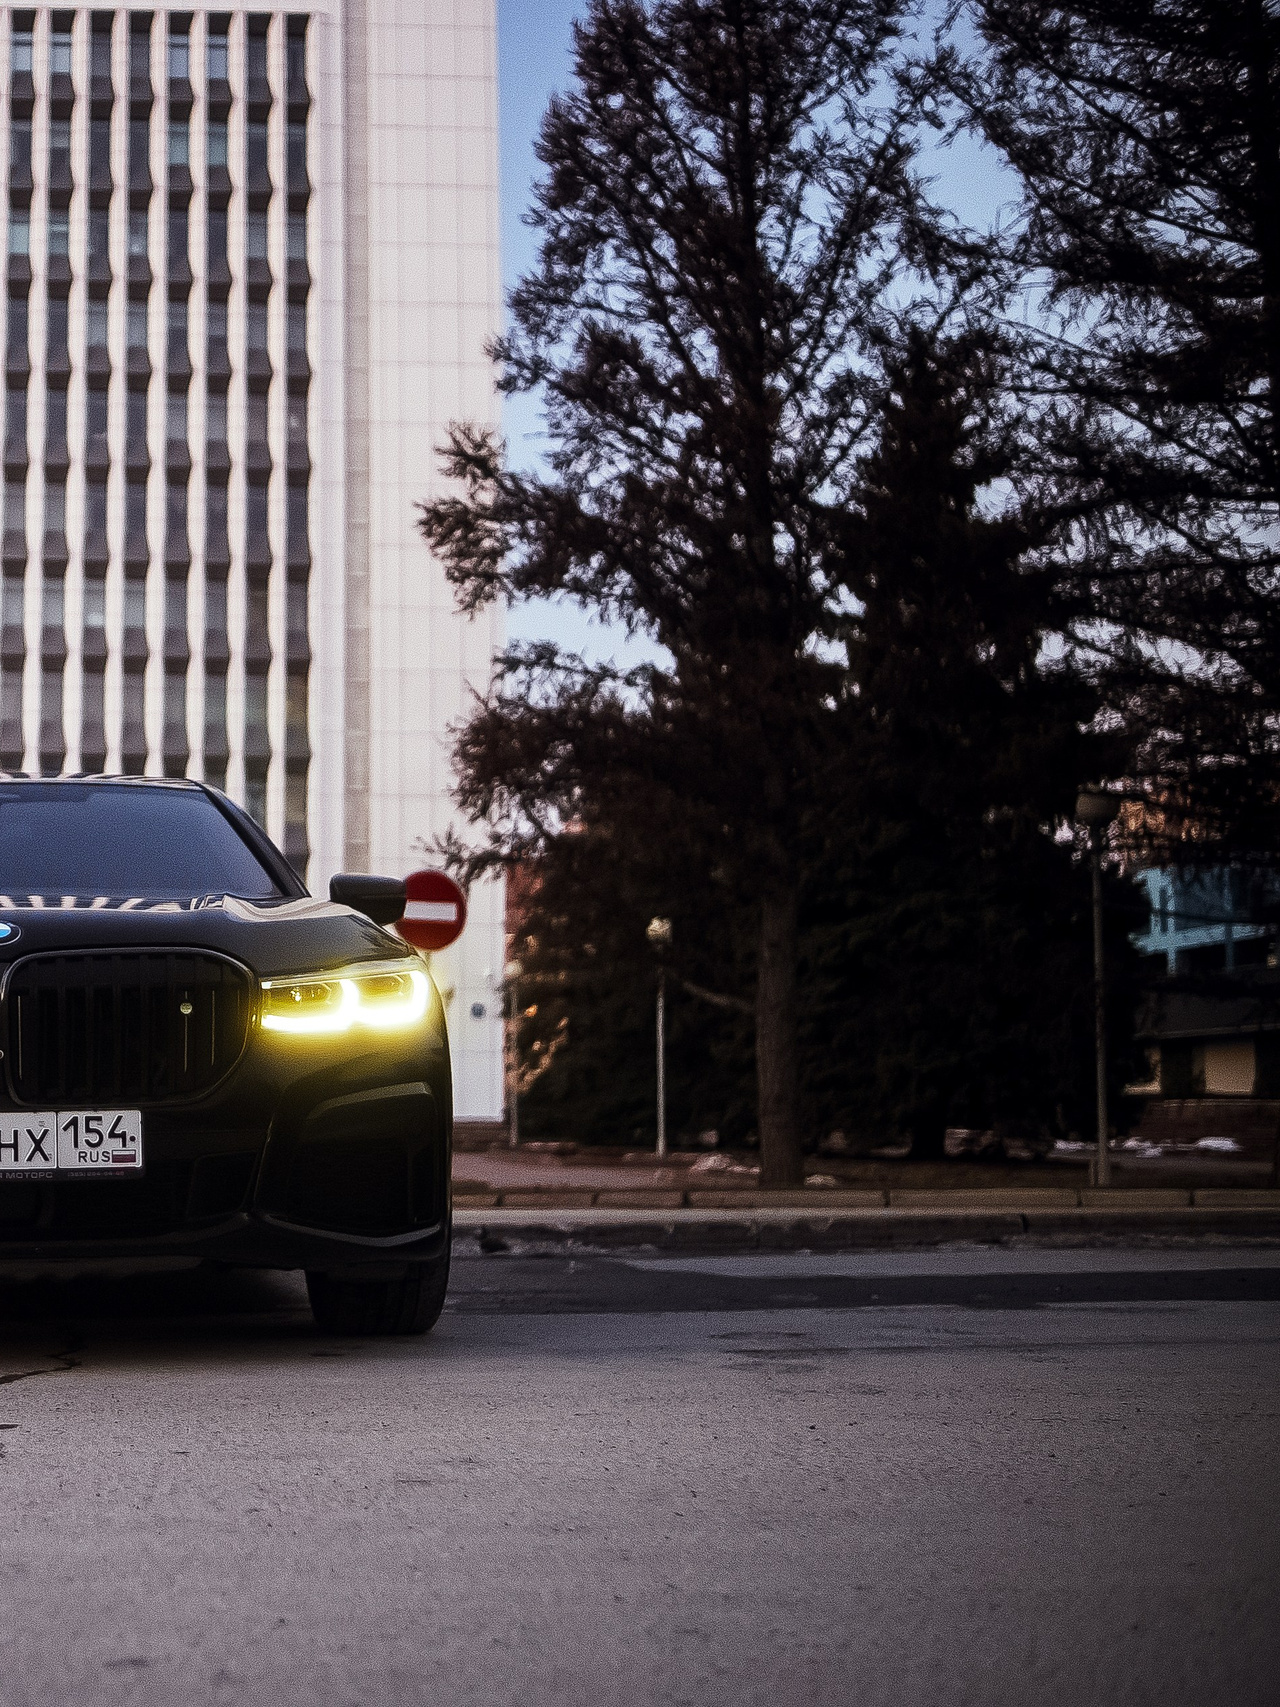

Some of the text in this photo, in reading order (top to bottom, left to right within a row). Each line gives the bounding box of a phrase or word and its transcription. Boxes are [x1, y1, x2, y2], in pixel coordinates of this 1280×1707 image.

[61, 1115, 128, 1149] 154
[77, 1150, 111, 1163] RUS
[5, 1171, 54, 1179] МОТОРС
